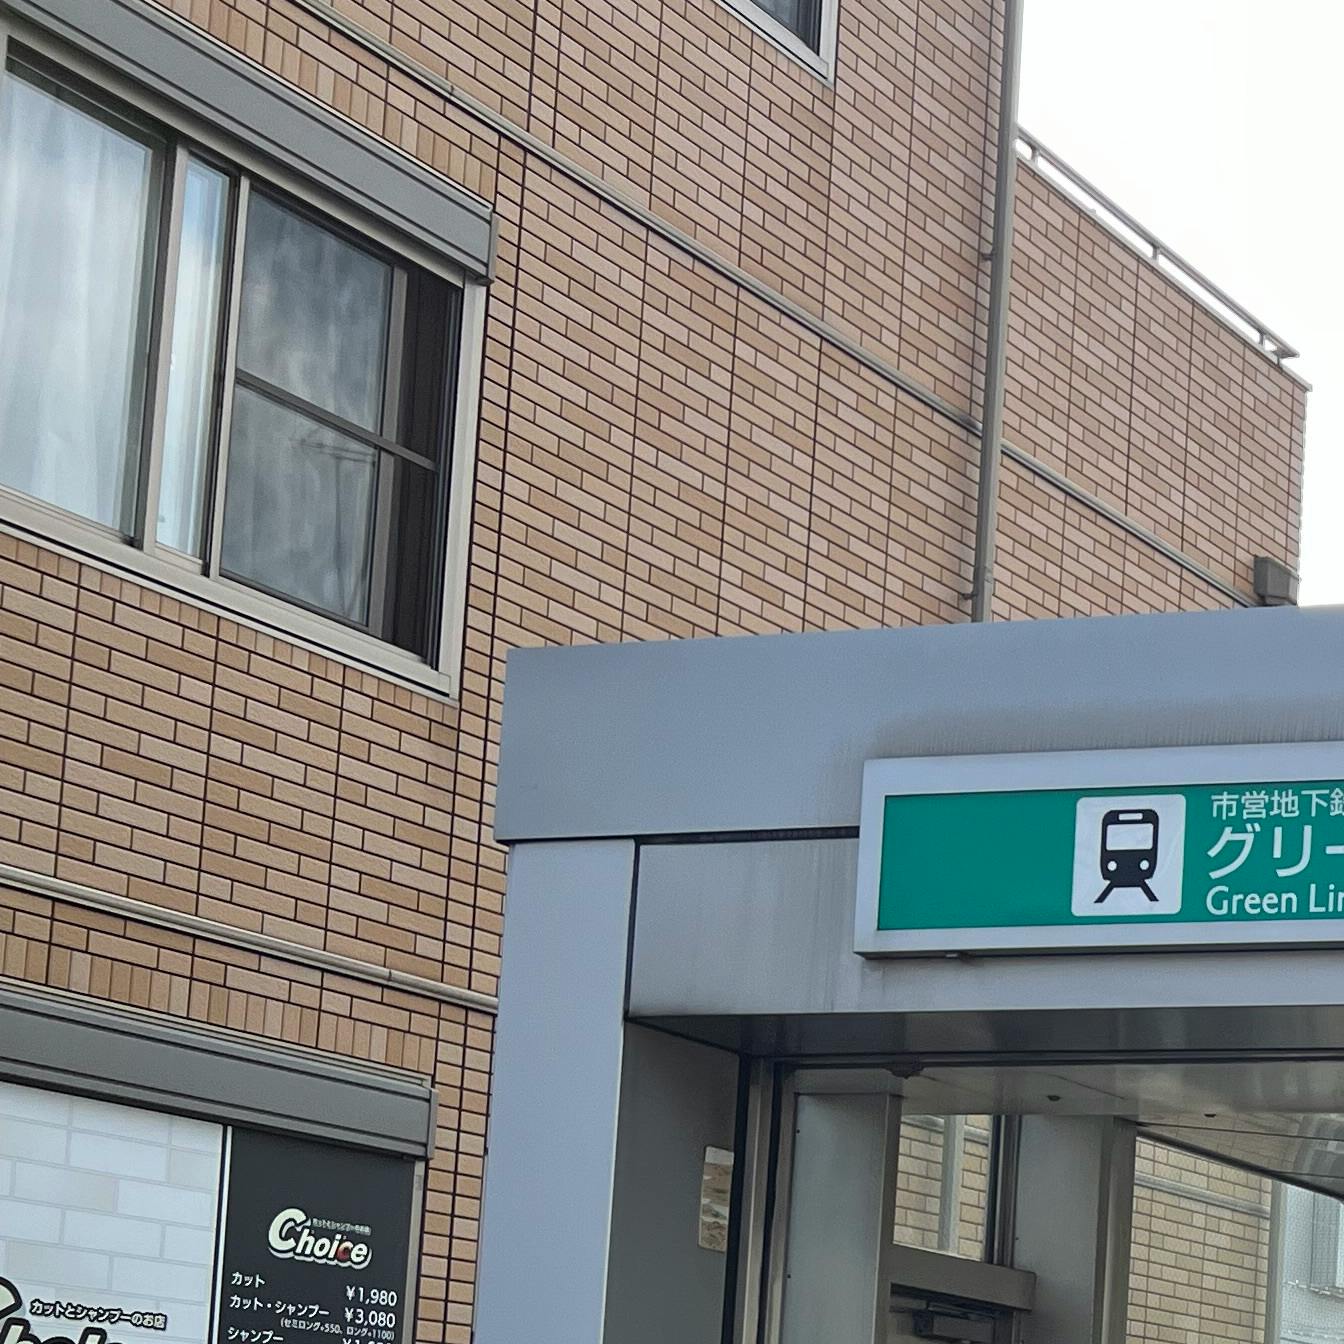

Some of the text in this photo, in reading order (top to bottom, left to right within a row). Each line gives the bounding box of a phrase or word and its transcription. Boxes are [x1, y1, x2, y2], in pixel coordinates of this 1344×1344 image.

[1205, 884, 1298, 916] Green
[268, 1207, 369, 1265] Choice
[231, 1271, 266, 1288] カット
[229, 1294, 330, 1318] カット・シャンプー
[346, 1284, 398, 1307] ¥1,980
[30, 1299, 168, 1331] カットとシャンプーのお店
[344, 1306, 396, 1328] ¥3,080
[227, 1326, 284, 1344] シャンプー
